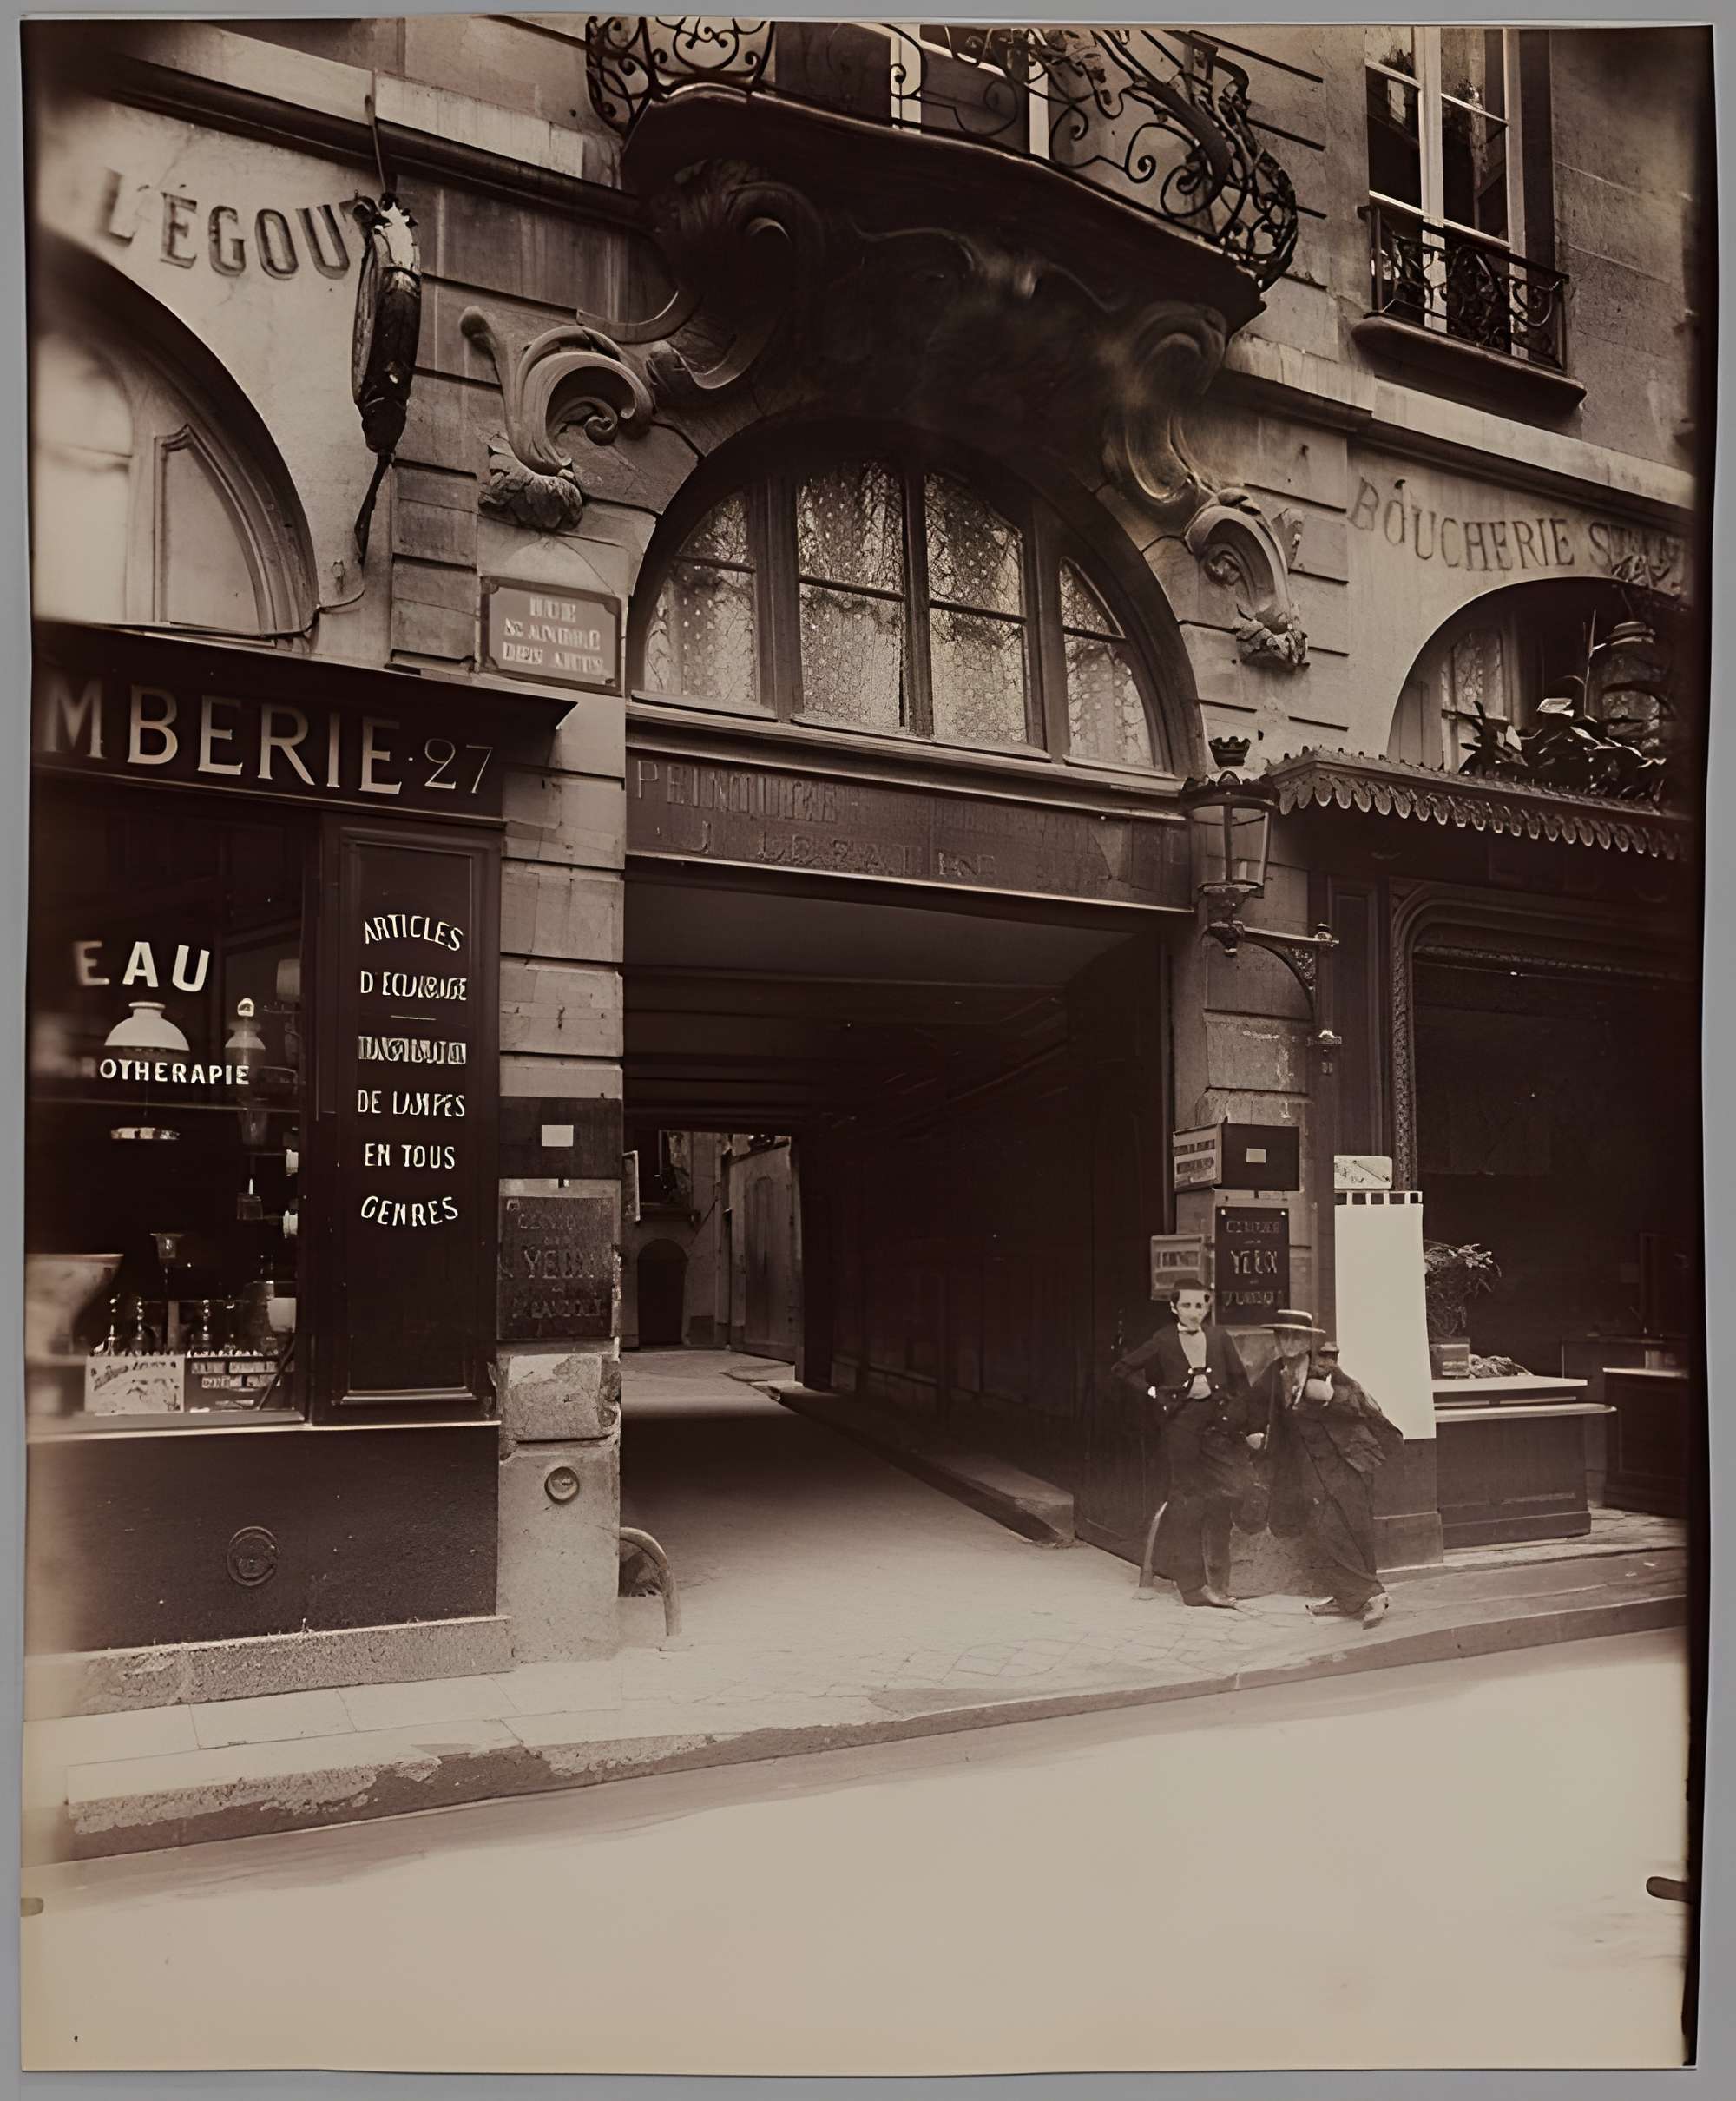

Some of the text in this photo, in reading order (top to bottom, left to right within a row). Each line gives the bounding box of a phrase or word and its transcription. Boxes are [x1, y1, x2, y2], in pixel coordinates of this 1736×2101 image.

[1346, 476, 1575, 572] BOUCHERIE
[424, 737, 494, 794] 27
[364, 913, 464, 952] ARTICLES
[357, 1089, 383, 1115] DE
[365, 1143, 456, 1170] EN TOUS
[360, 1195, 459, 1228] GENRES
